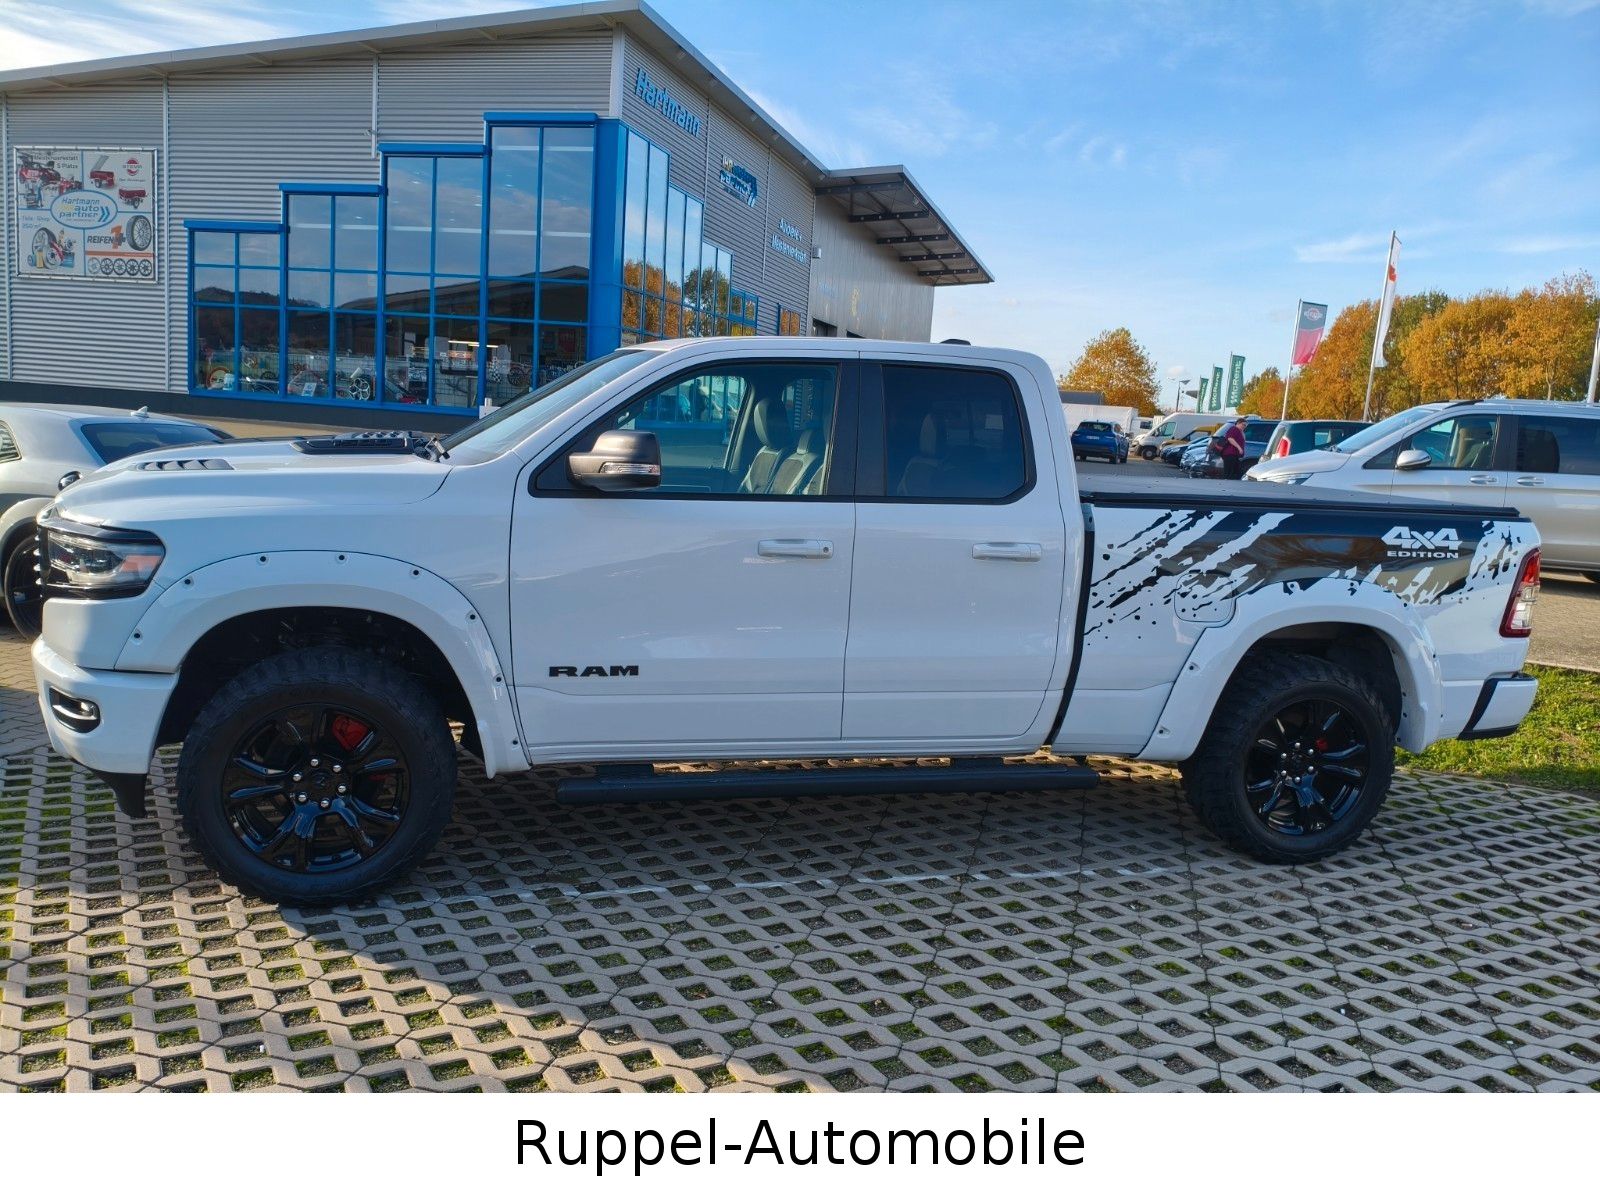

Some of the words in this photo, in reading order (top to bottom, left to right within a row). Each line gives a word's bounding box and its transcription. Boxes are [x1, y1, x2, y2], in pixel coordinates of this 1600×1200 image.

[635, 67, 701, 139] Hartmann
[62, 196, 100, 205] Hartmann
[59, 211, 99, 219] partner
[1231, 359, 1241, 405] McRent
[1211, 371, 1221, 408] McRent
[1386, 550, 1459, 559] EDITION
[548, 665, 639, 677] RAM
